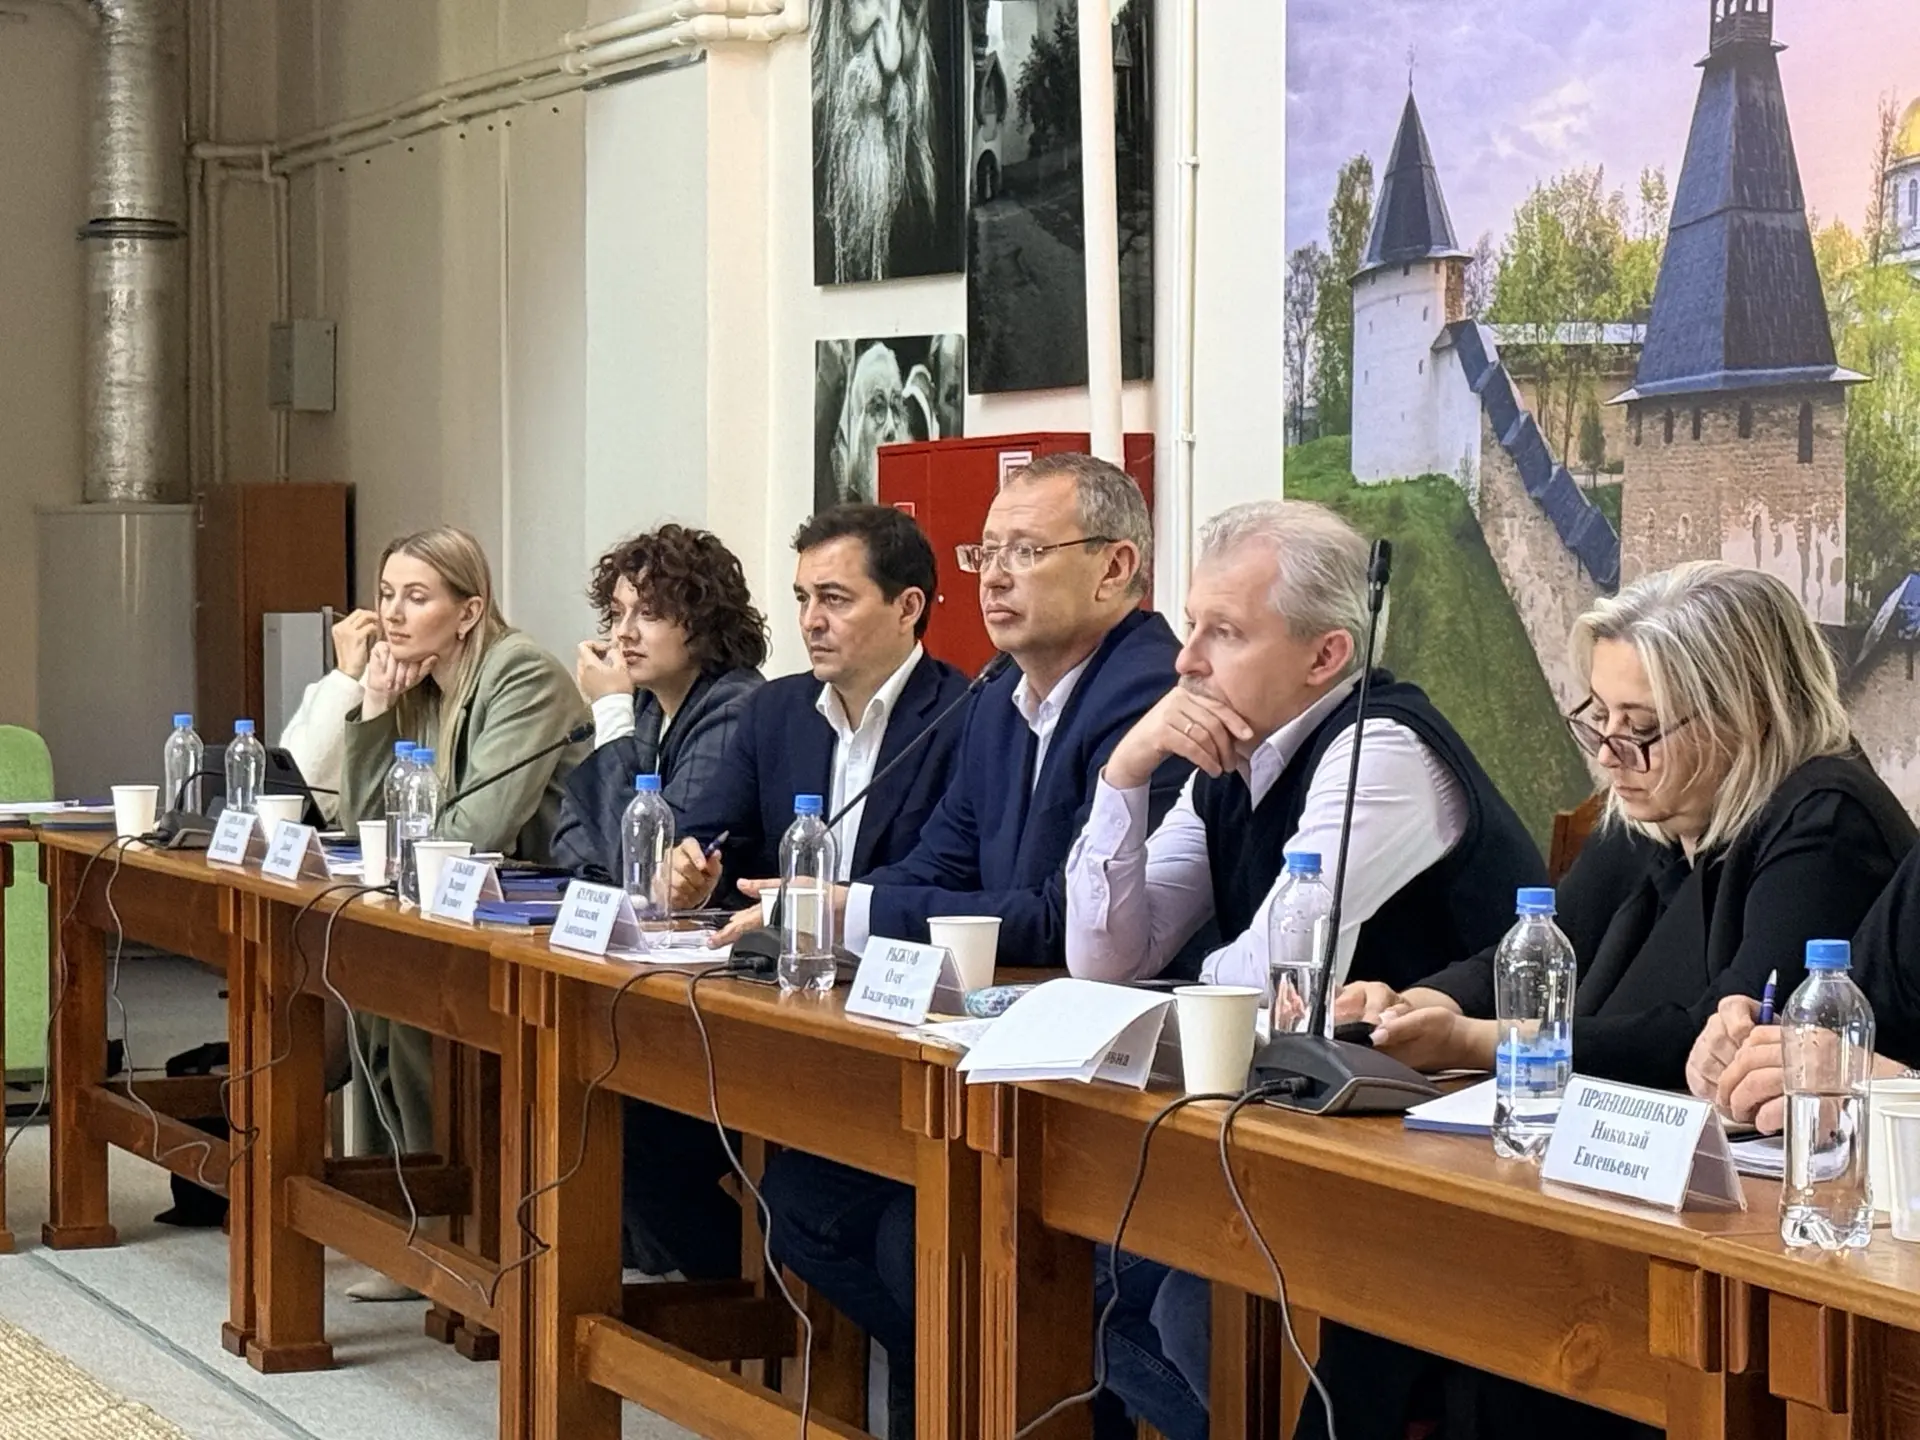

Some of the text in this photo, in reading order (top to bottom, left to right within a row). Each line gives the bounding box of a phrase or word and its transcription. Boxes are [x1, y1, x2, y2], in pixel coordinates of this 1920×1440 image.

[1577, 1087, 1688, 1127] ПРЯНИШНИКОВ
[1590, 1119, 1650, 1150] Николай
[1573, 1145, 1650, 1181] Евгеньевич
